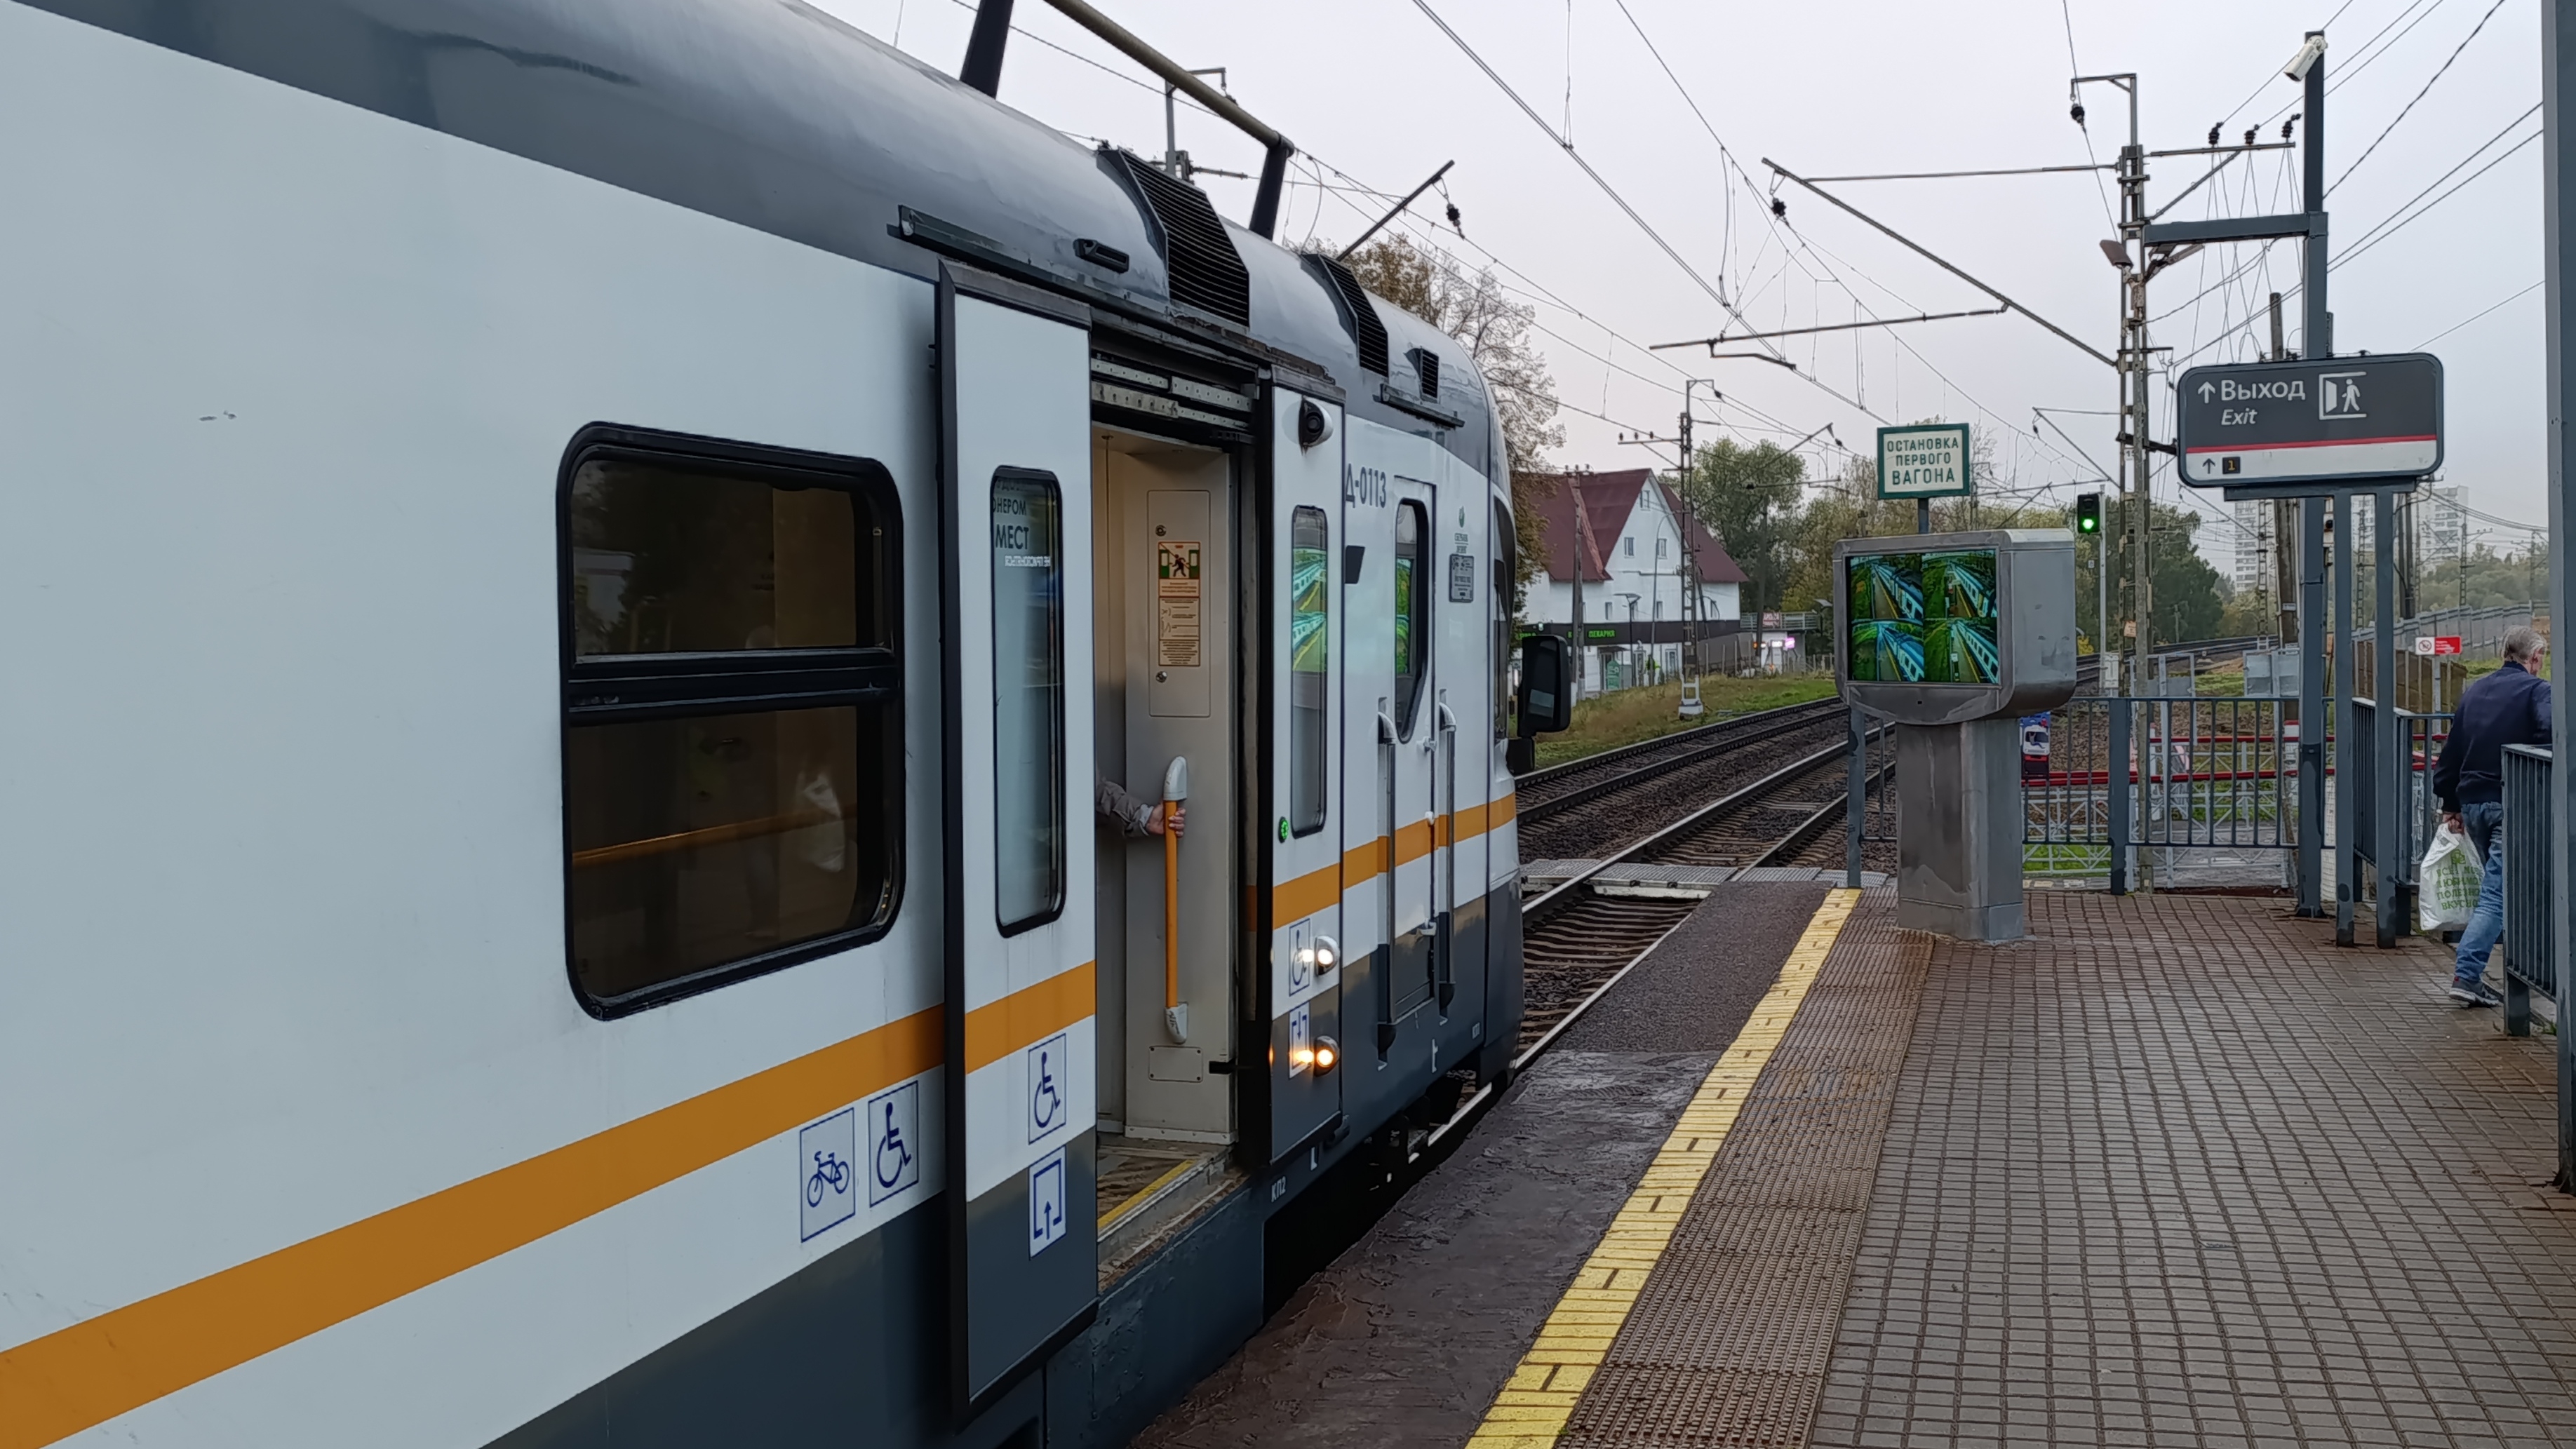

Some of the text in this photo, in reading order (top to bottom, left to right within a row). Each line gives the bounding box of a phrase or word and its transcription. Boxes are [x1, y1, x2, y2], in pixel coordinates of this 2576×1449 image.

[2221, 379, 2306, 401] Выход
[2221, 407, 2258, 425] Exit
[1887, 437, 1959, 452] ОСТАНОВКА
[1896, 452, 1951, 466] ПЕРВОГО
[2227, 459, 2236, 471] 1
[1892, 467, 1955, 485] ВАГОНА
[1346, 463, 1386, 508] Д-0113
[995, 524, 1029, 550] МЕСТ
